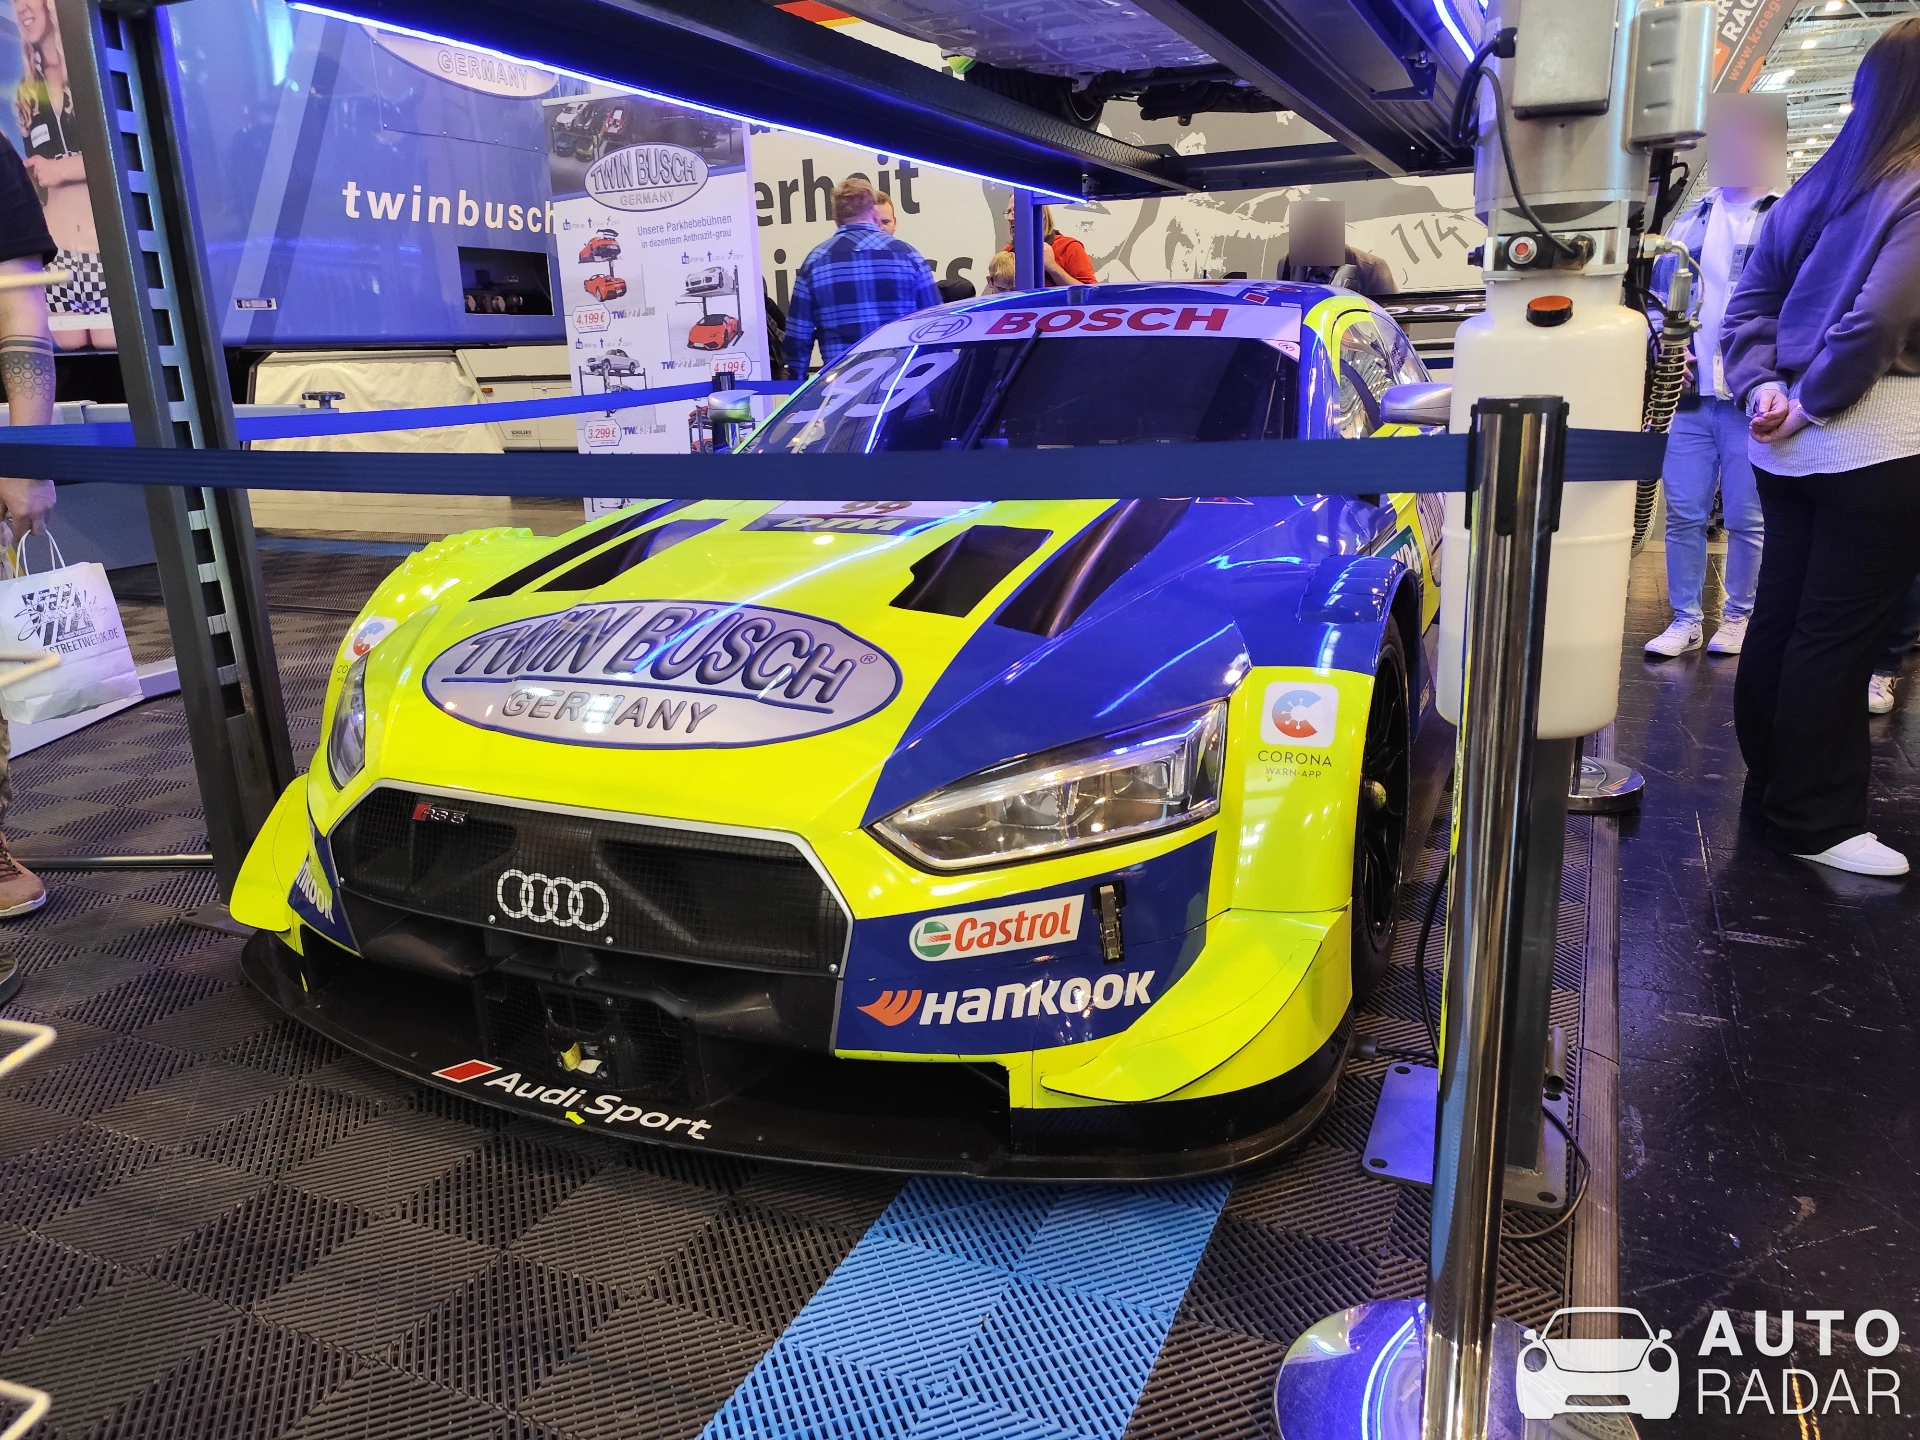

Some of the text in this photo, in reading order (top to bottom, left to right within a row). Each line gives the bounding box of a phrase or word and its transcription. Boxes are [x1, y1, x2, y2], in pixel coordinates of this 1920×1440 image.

[438, 50, 528, 91] GERMANY
[591, 148, 697, 191] TWIN BUSCH
[620, 190, 675, 206] GERMANY
[637, 215, 732, 236] Unsere Parkhebebühnen
[641, 229, 732, 248] in dezentem Anthrazit-grau
[577, 312, 599, 324] 4.199
[984, 308, 1229, 335] BOSCH
[786, 351, 960, 424] 99
[588, 427, 610, 439] 3.299
[773, 517, 907, 531] DTM
[454, 606, 857, 703] TWIN BUSCH
[502, 689, 717, 733] GERMANY
[1258, 750, 1332, 767] CORONA
[1265, 766, 1322, 778] WARN-APP
[954, 902, 1071, 951] Castrol
[484, 1072, 712, 1140] Audi Sport
